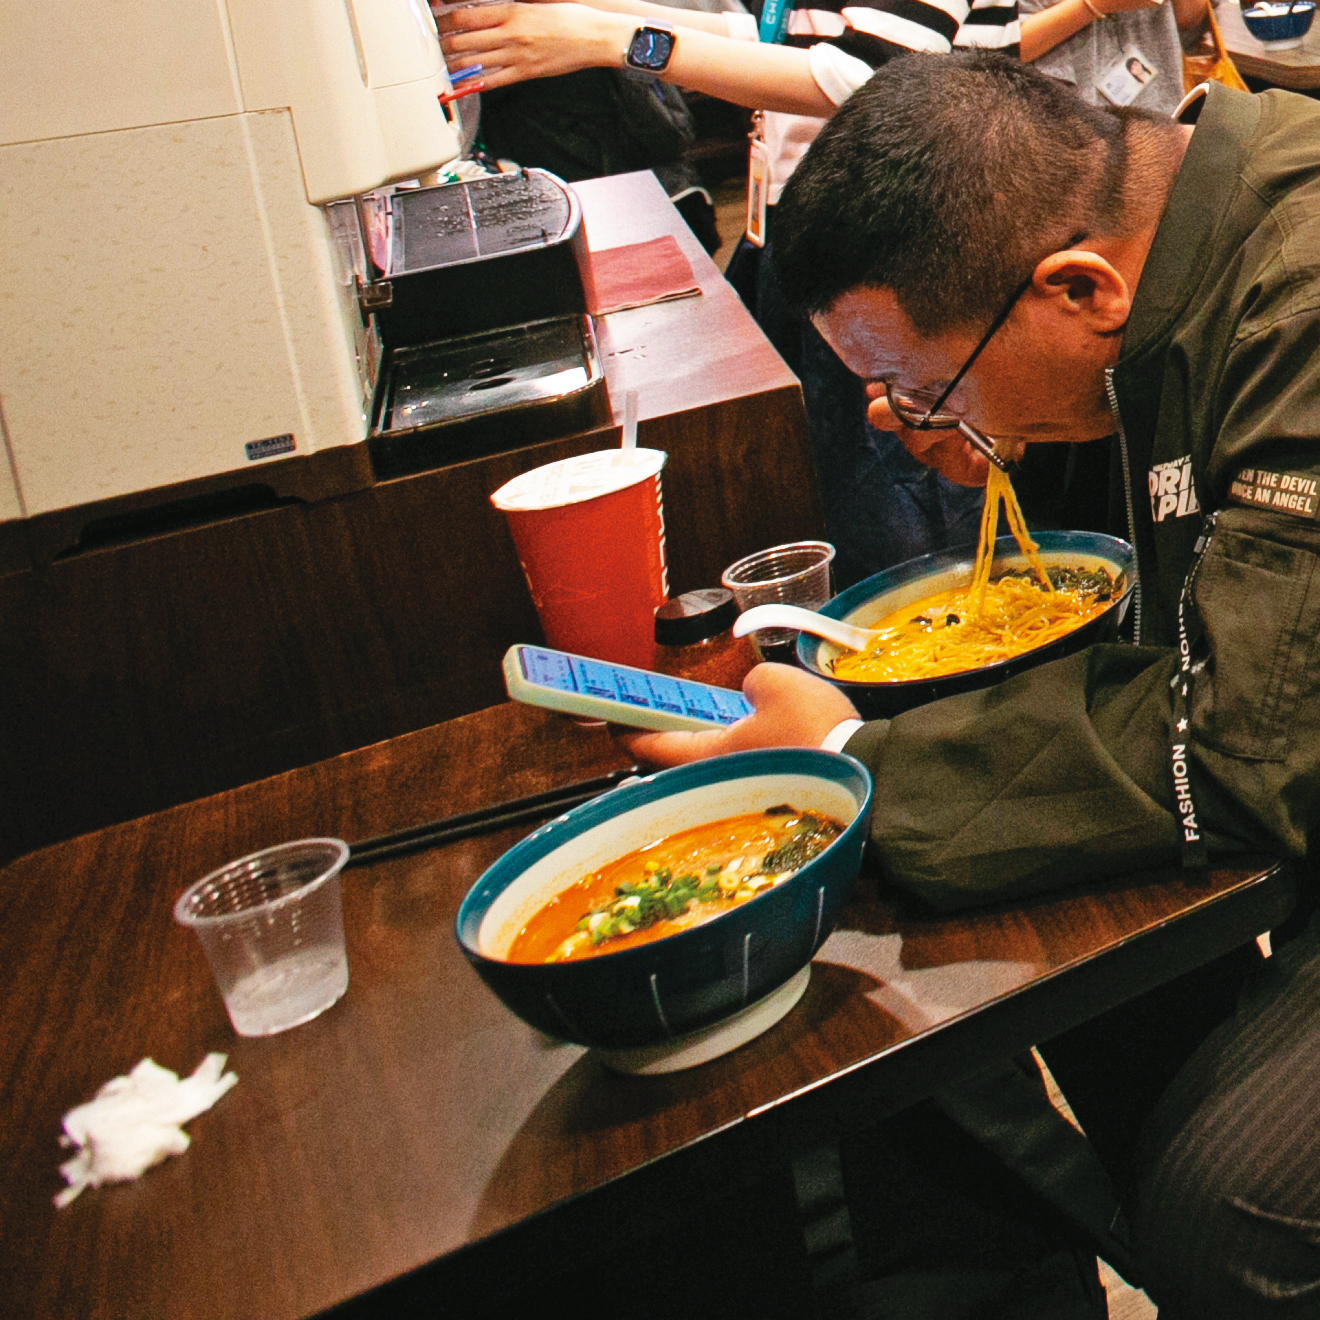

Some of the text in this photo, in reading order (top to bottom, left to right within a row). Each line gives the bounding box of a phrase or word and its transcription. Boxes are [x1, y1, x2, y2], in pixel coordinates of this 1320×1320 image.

[1148, 462, 1194, 497] DRI
[1237, 468, 1317, 496] EN THE DEVIL
[1254, 487, 1271, 503] AN
[1272, 491, 1313, 513] ANGEL
[1172, 744, 1200, 842] FASHION
